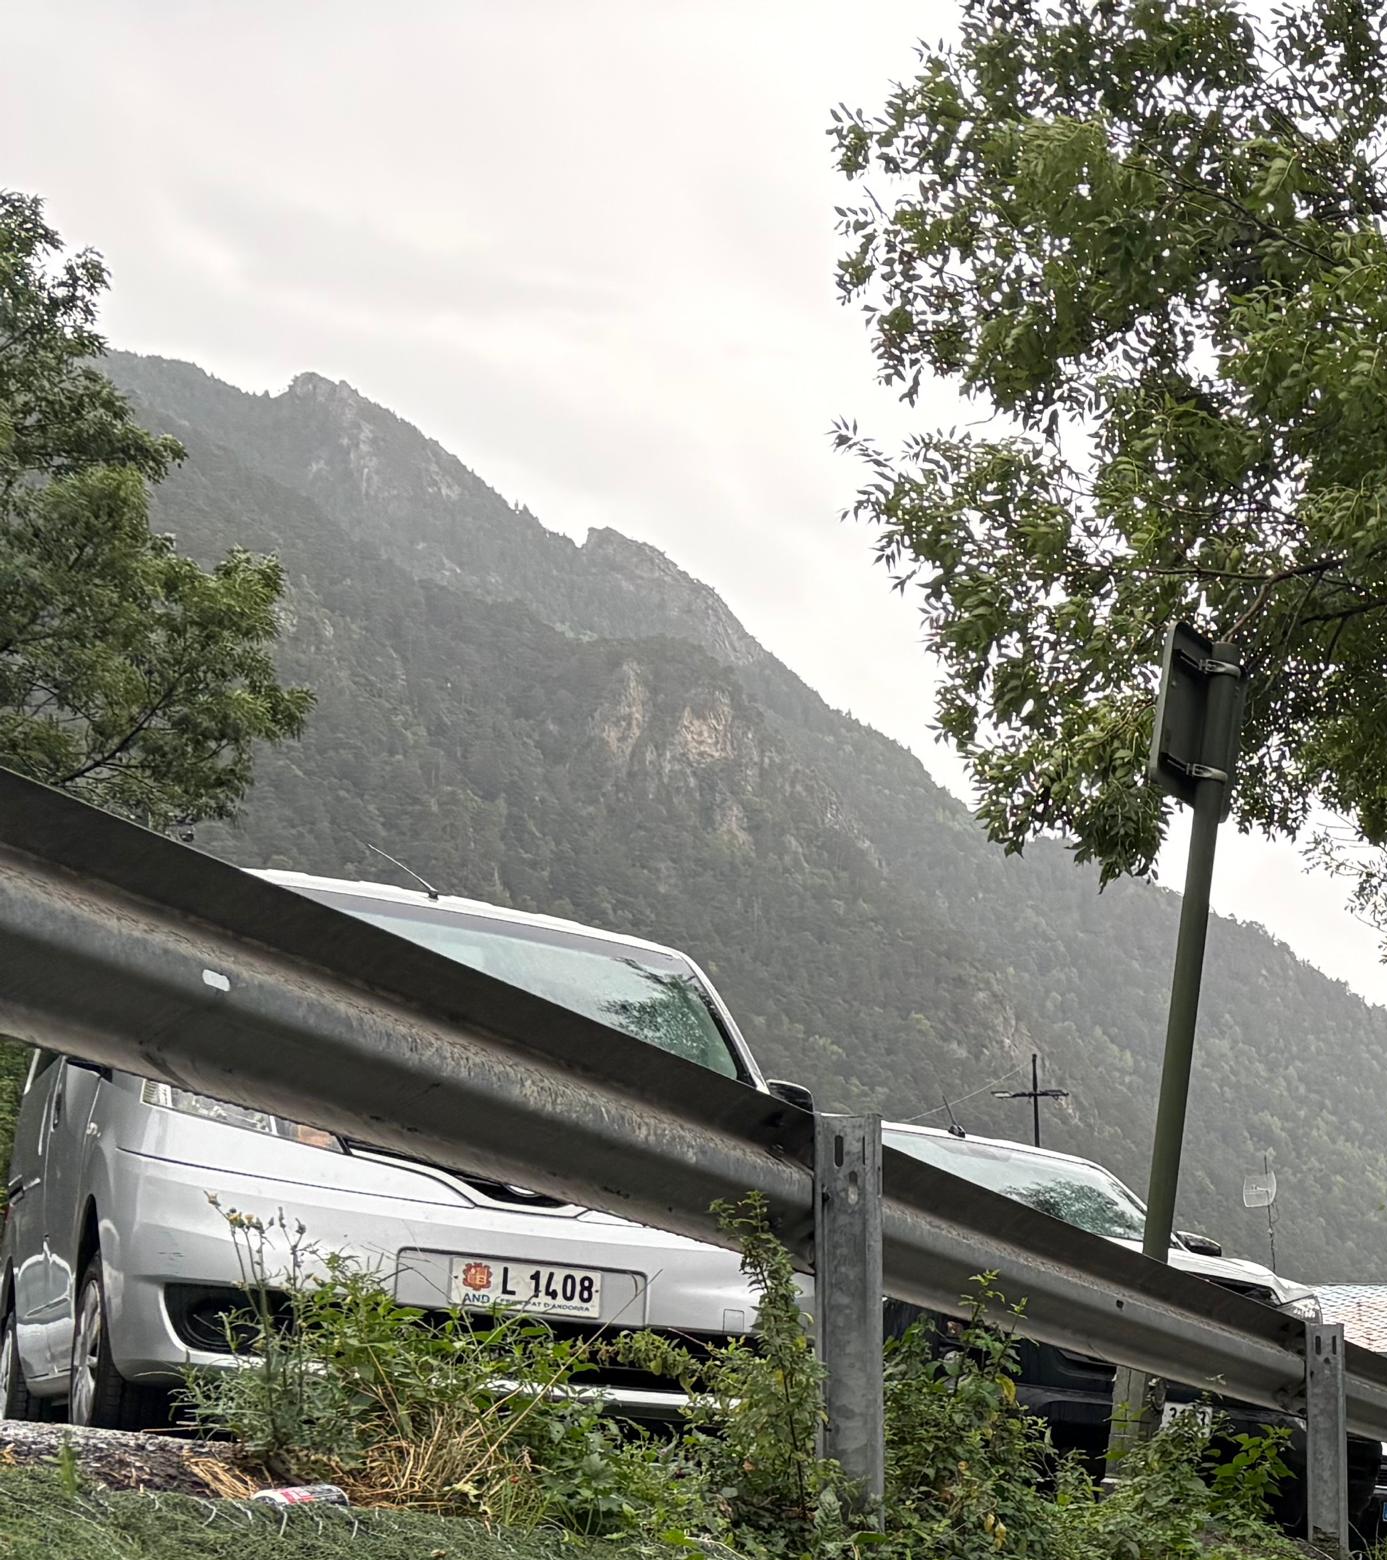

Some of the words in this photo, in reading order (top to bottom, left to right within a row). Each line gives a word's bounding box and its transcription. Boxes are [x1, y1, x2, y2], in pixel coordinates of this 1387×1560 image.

[501, 1266, 516, 1296] L
[530, 1270, 594, 1303] 1408
[463, 1292, 491, 1304] AND
